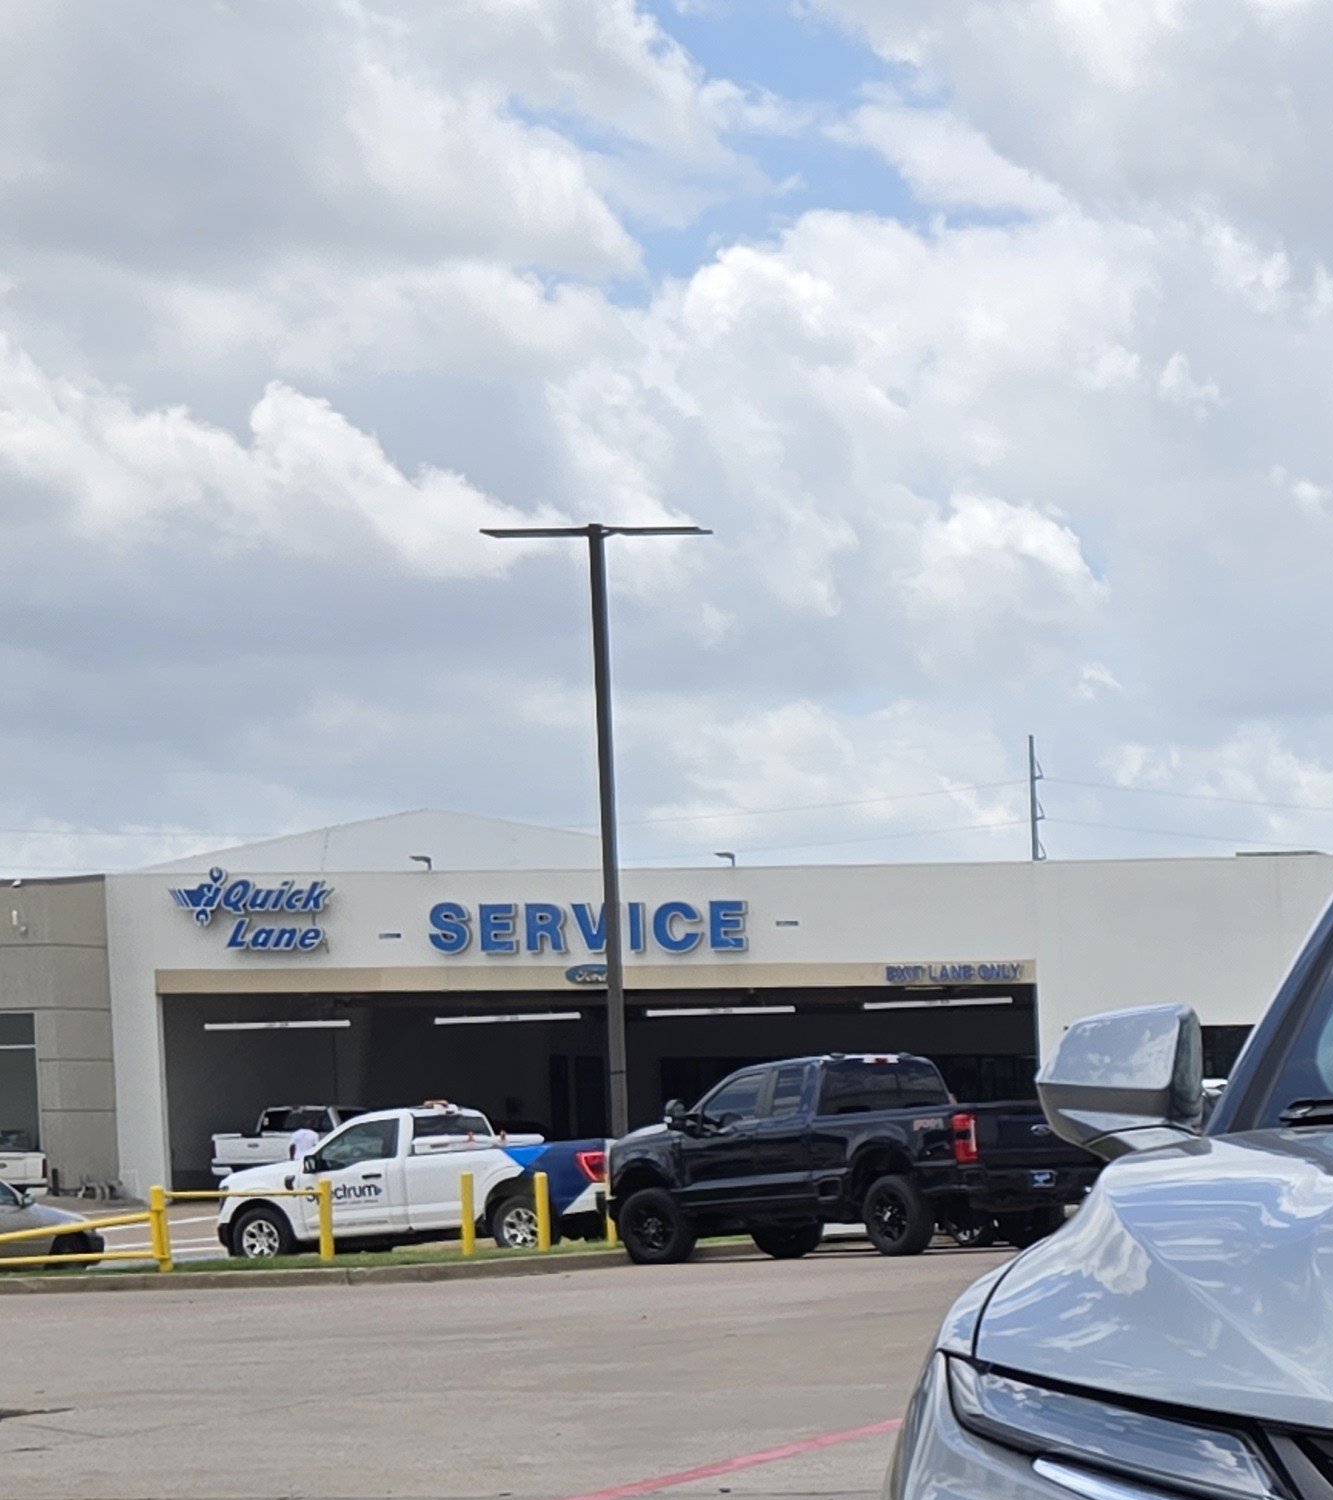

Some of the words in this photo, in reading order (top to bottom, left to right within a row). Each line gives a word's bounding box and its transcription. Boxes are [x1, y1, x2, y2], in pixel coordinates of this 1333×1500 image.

[220, 877, 331, 914] Quick
[227, 917, 327, 952] Lane
[428, 899, 749, 956] SERVICE
[928, 964, 976, 981] LANE
[977, 962, 1021, 981] ONLY
